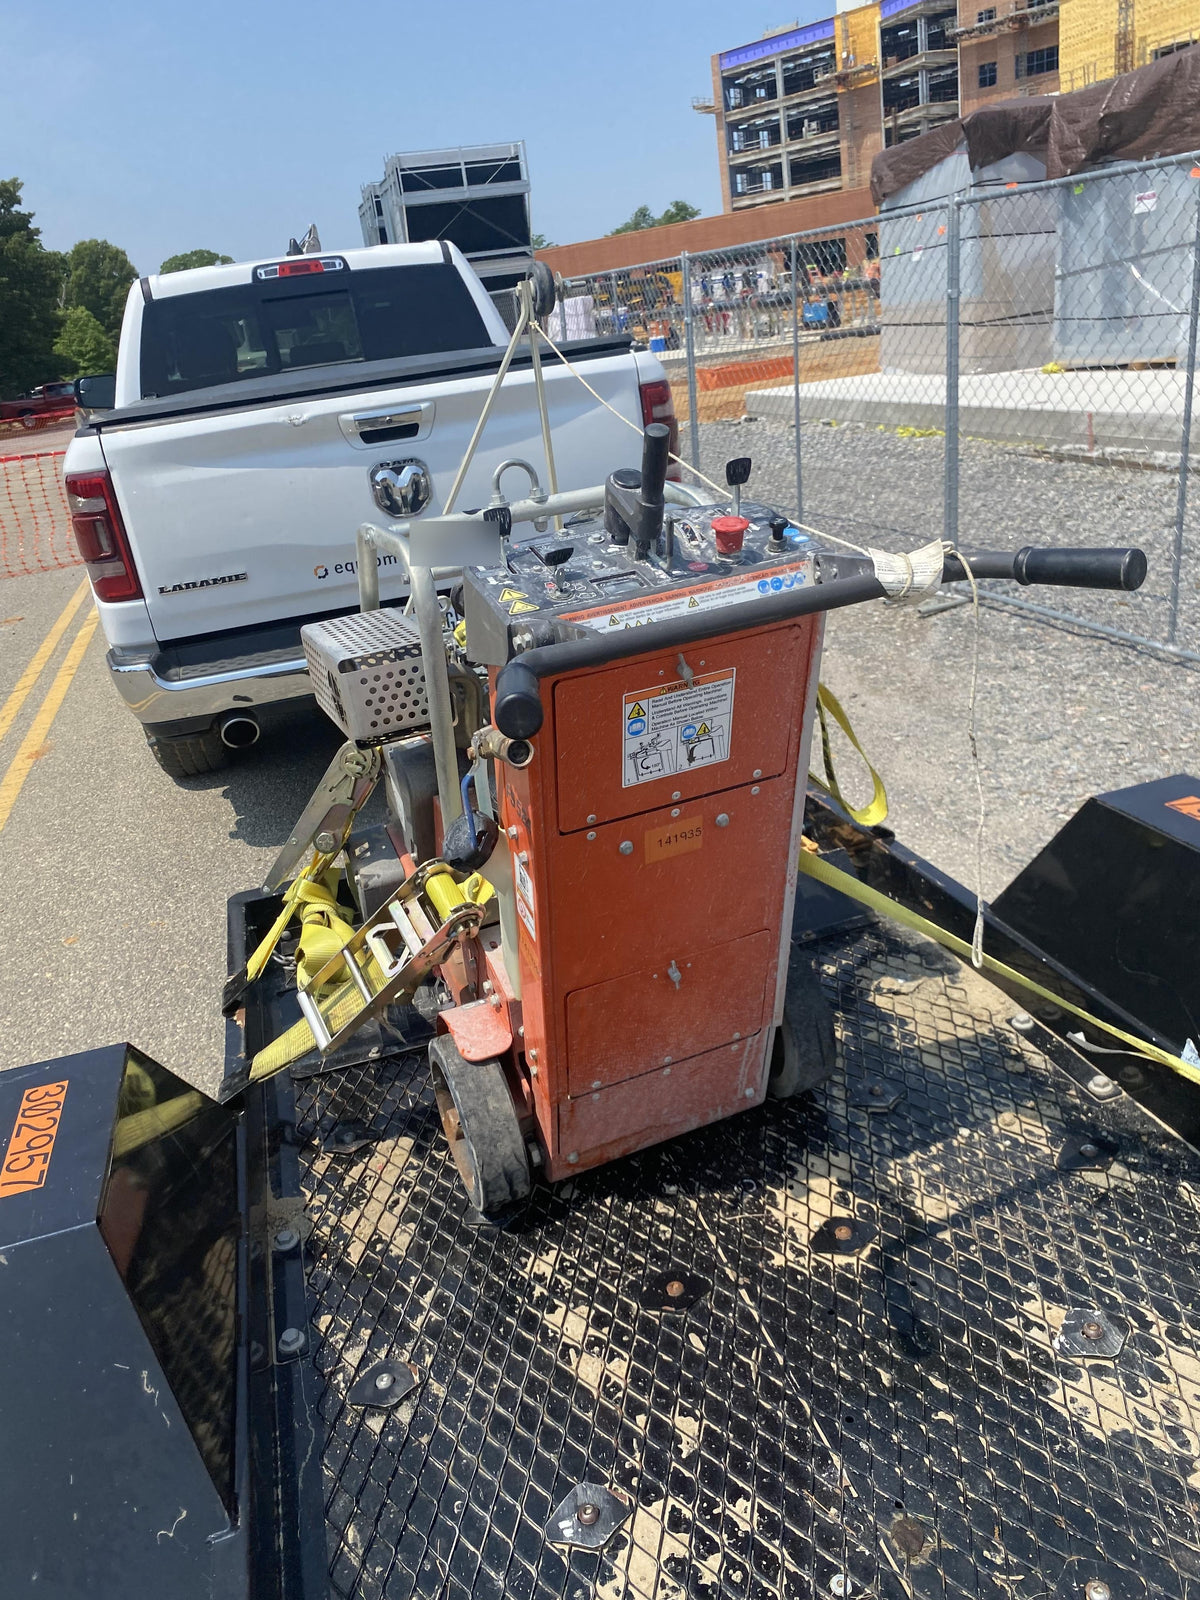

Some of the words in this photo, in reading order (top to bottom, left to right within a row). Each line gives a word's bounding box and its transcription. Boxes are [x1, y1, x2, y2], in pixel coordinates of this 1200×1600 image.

[158, 572, 248, 594] LARAMIE
[668, 680, 700, 692] WARNNG
[674, 689, 697, 698] Understand
[652, 706, 676, 715] Understand
[652, 718, 672, 726] Operation
[658, 826, 702, 848] 141935
[0, 1084, 66, 1187] 302957
